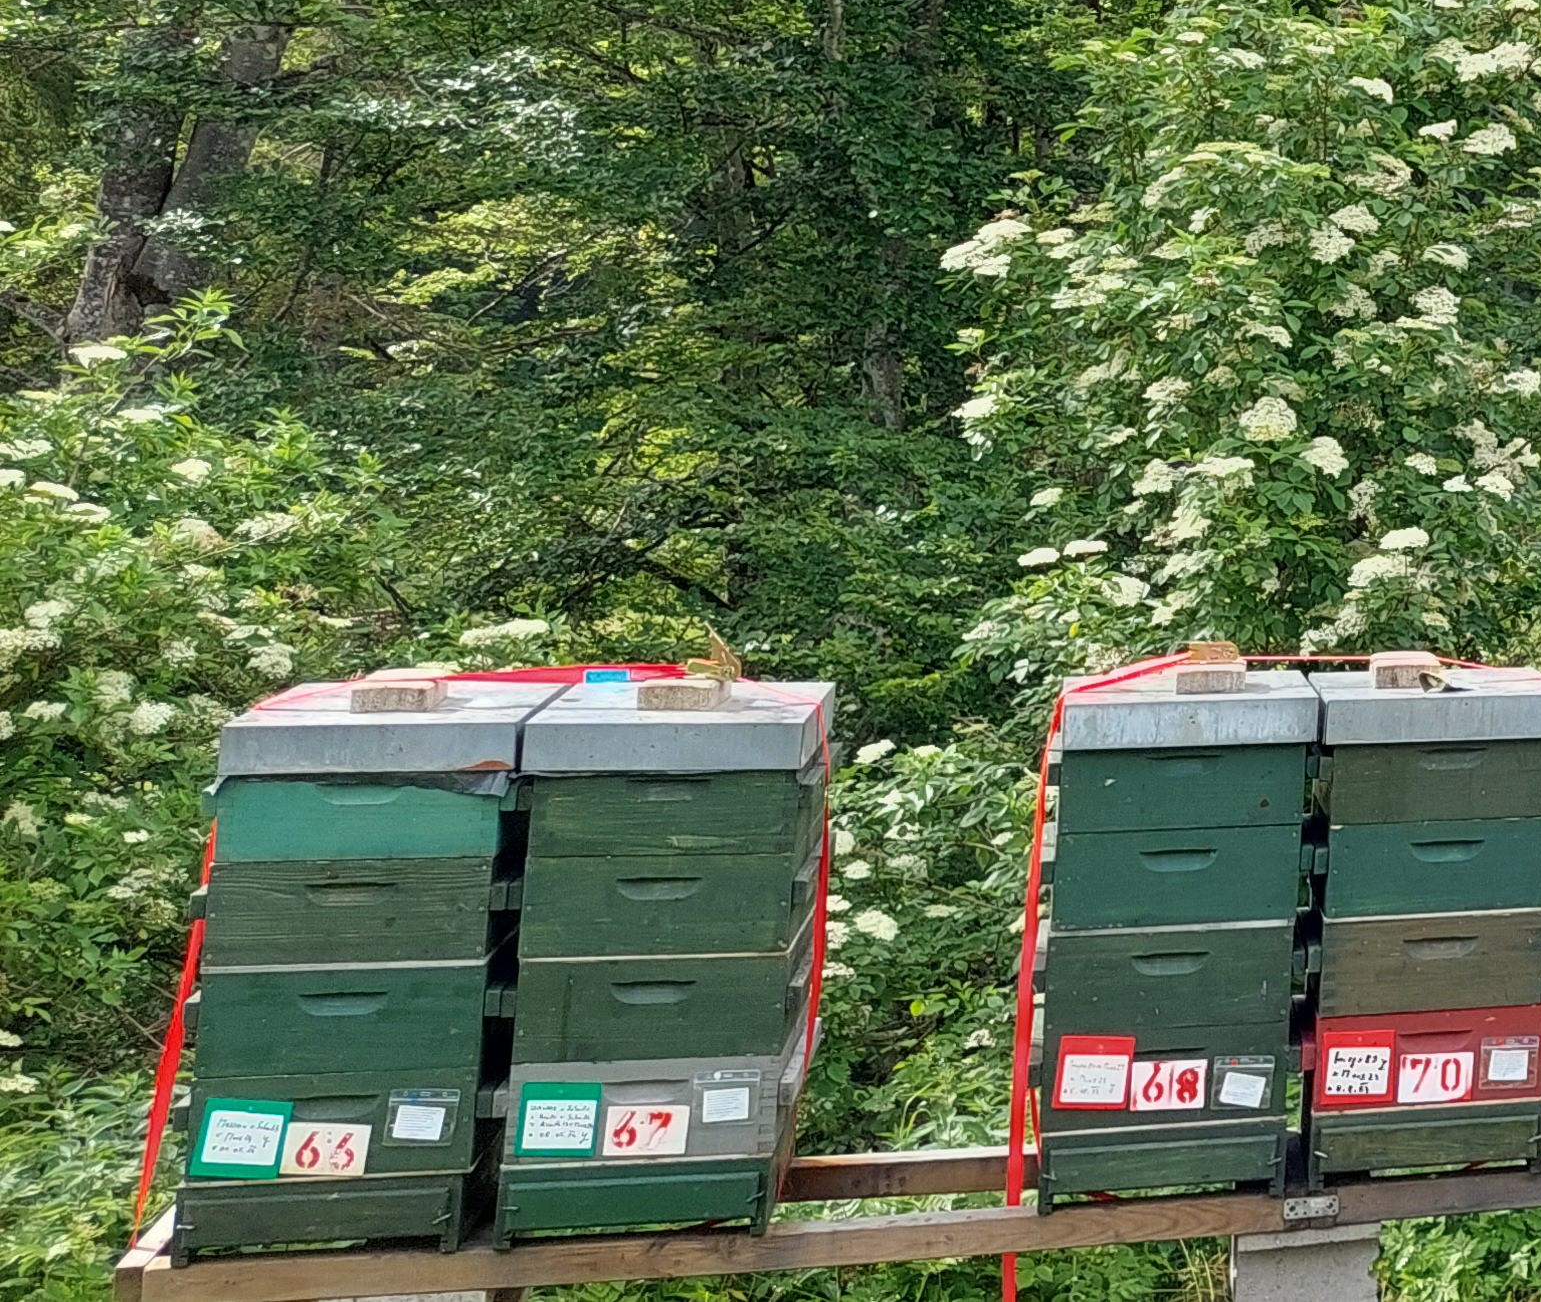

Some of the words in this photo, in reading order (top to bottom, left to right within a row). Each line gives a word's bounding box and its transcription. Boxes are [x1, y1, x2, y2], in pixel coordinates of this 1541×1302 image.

[1142, 1061, 1199, 1104] 68
[1409, 1056, 1462, 1094] 70
[612, 1110, 673, 1150] 67
[295, 1131, 355, 1170] 66
